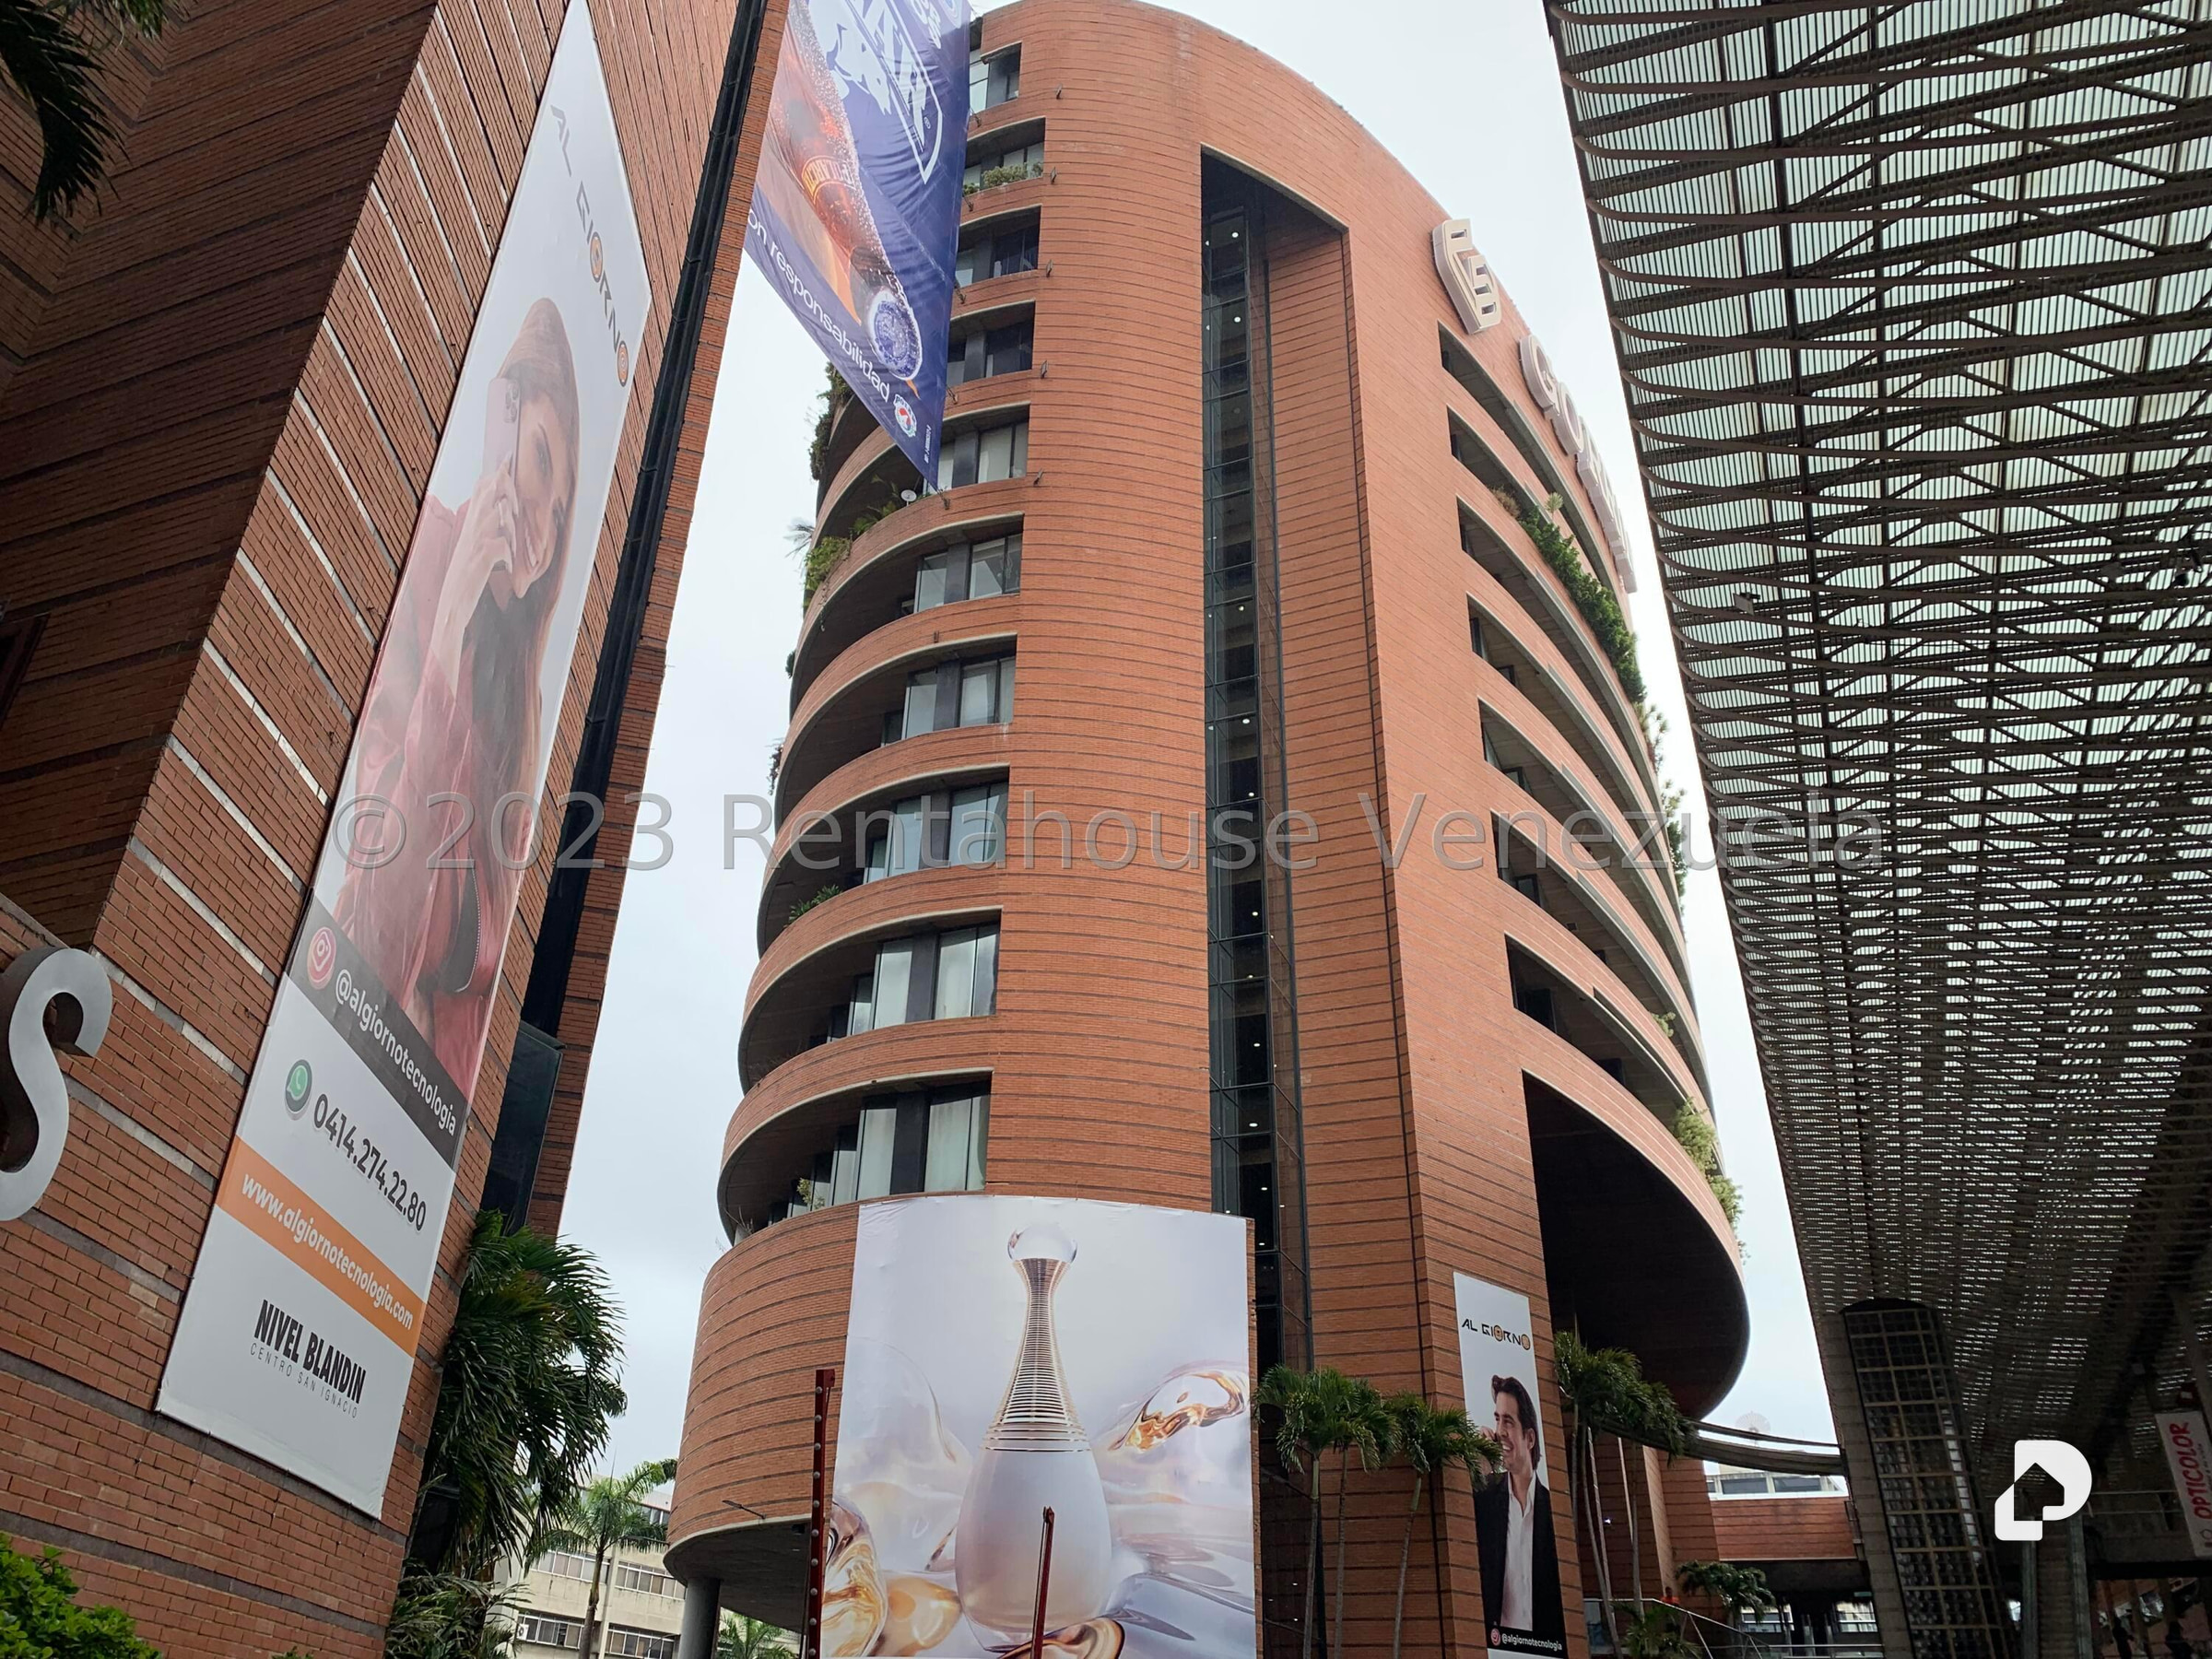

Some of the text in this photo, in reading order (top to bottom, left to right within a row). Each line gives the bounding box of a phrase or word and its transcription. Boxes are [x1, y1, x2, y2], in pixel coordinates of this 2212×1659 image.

[550, 104, 629, 387] AL GIORNO
[747, 211, 890, 403] on responsabilidad
[335, 969, 457, 1136] @algiornotecnologia
[313, 1093, 427, 1231] 0414.274.22.80
[241, 1173, 414, 1331] www.algiornotecnologia.com
[250, 1342, 358, 1419] CENTRO SAN IGNACIO
[253, 1299, 366, 1405] NIVEL BLANDIN
[1462, 1318, 1531, 1351] AL GIORNO
[2170, 1421, 2212, 1520] OPTICOLOR
[1501, 1633, 1563, 1652] @algiornotecnologia
